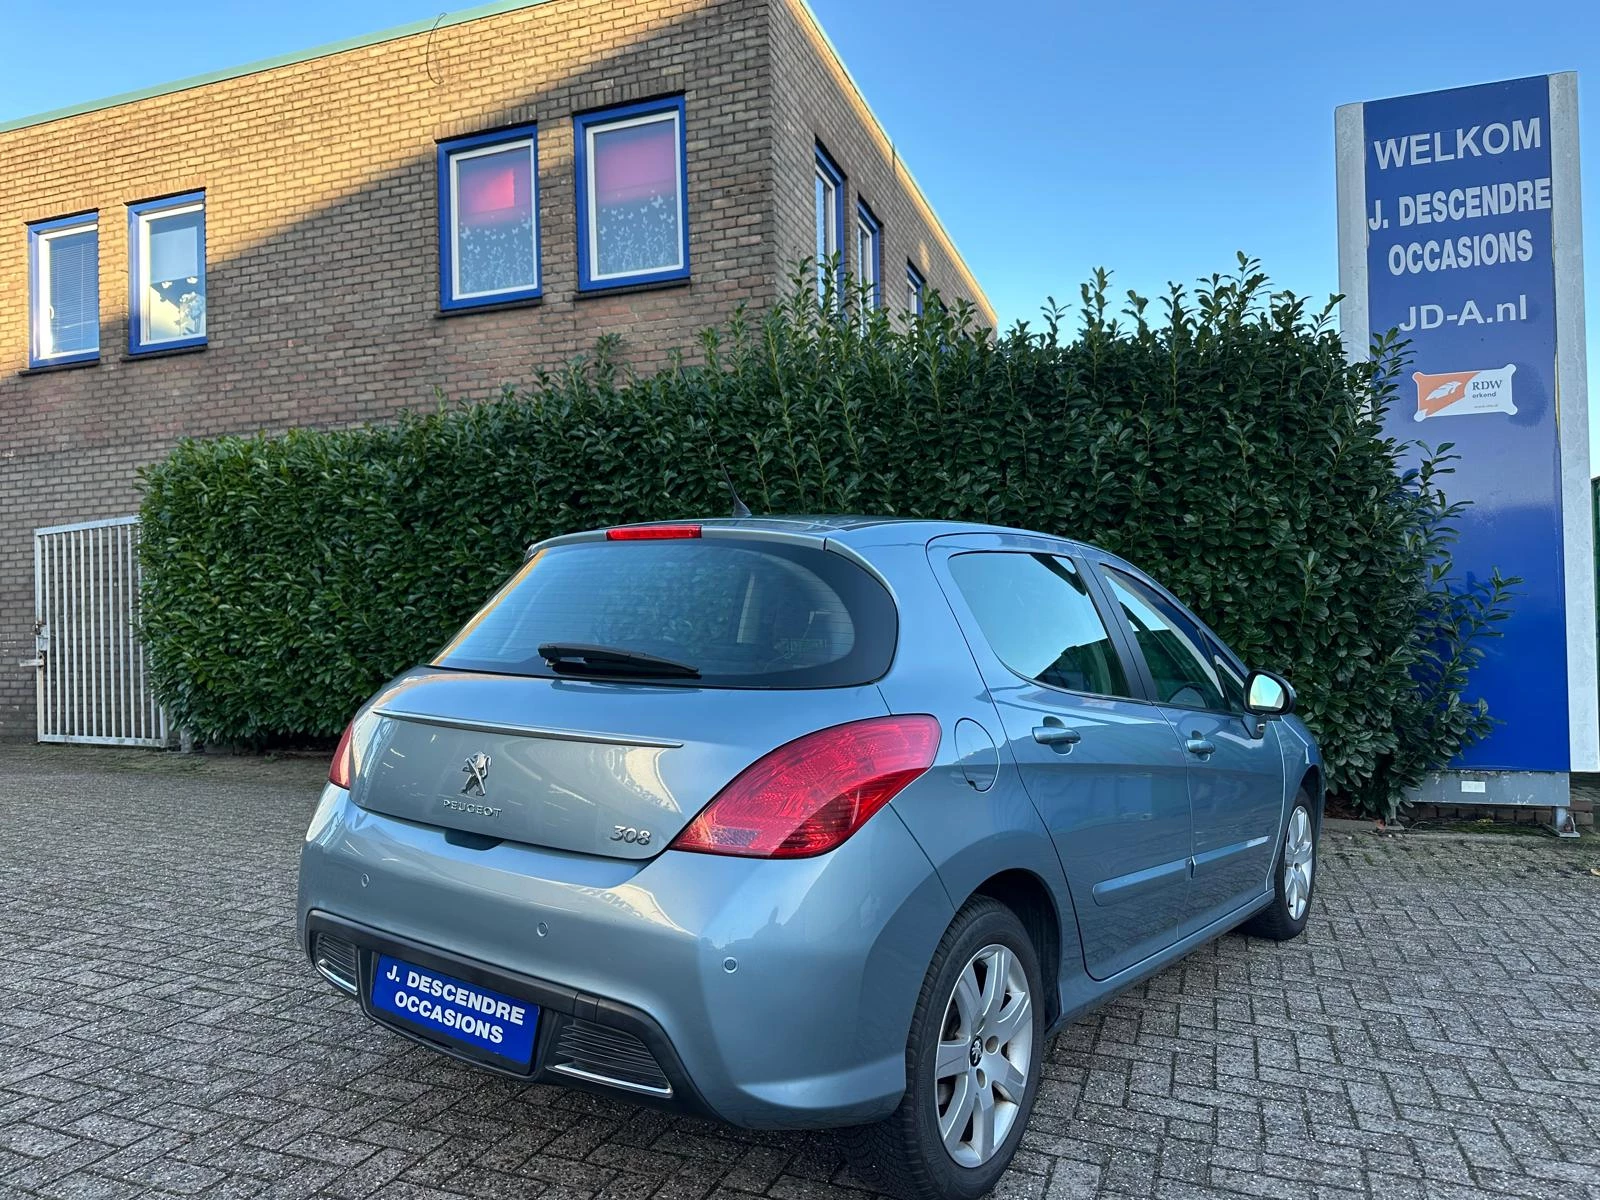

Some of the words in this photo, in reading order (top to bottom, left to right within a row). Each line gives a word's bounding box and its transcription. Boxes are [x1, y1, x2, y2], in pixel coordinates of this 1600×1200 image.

[1373, 117, 1541, 170] WELKOM
[1369, 200, 1389, 231] J.
[1399, 177, 1552, 226] DESCENDRE
[1388, 229, 1533, 276] OCCASIONS
[1399, 294, 1527, 332] JD-A.nl
[1472, 380, 1502, 391] RDW
[1472, 391, 1497, 399] erkend
[443, 799, 502, 818] PEUGEOT
[609, 825, 651, 846] 308
[386, 965, 400, 983] J.
[406, 971, 526, 1026] DESCENDRE
[394, 991, 504, 1044] OCCASIONS
